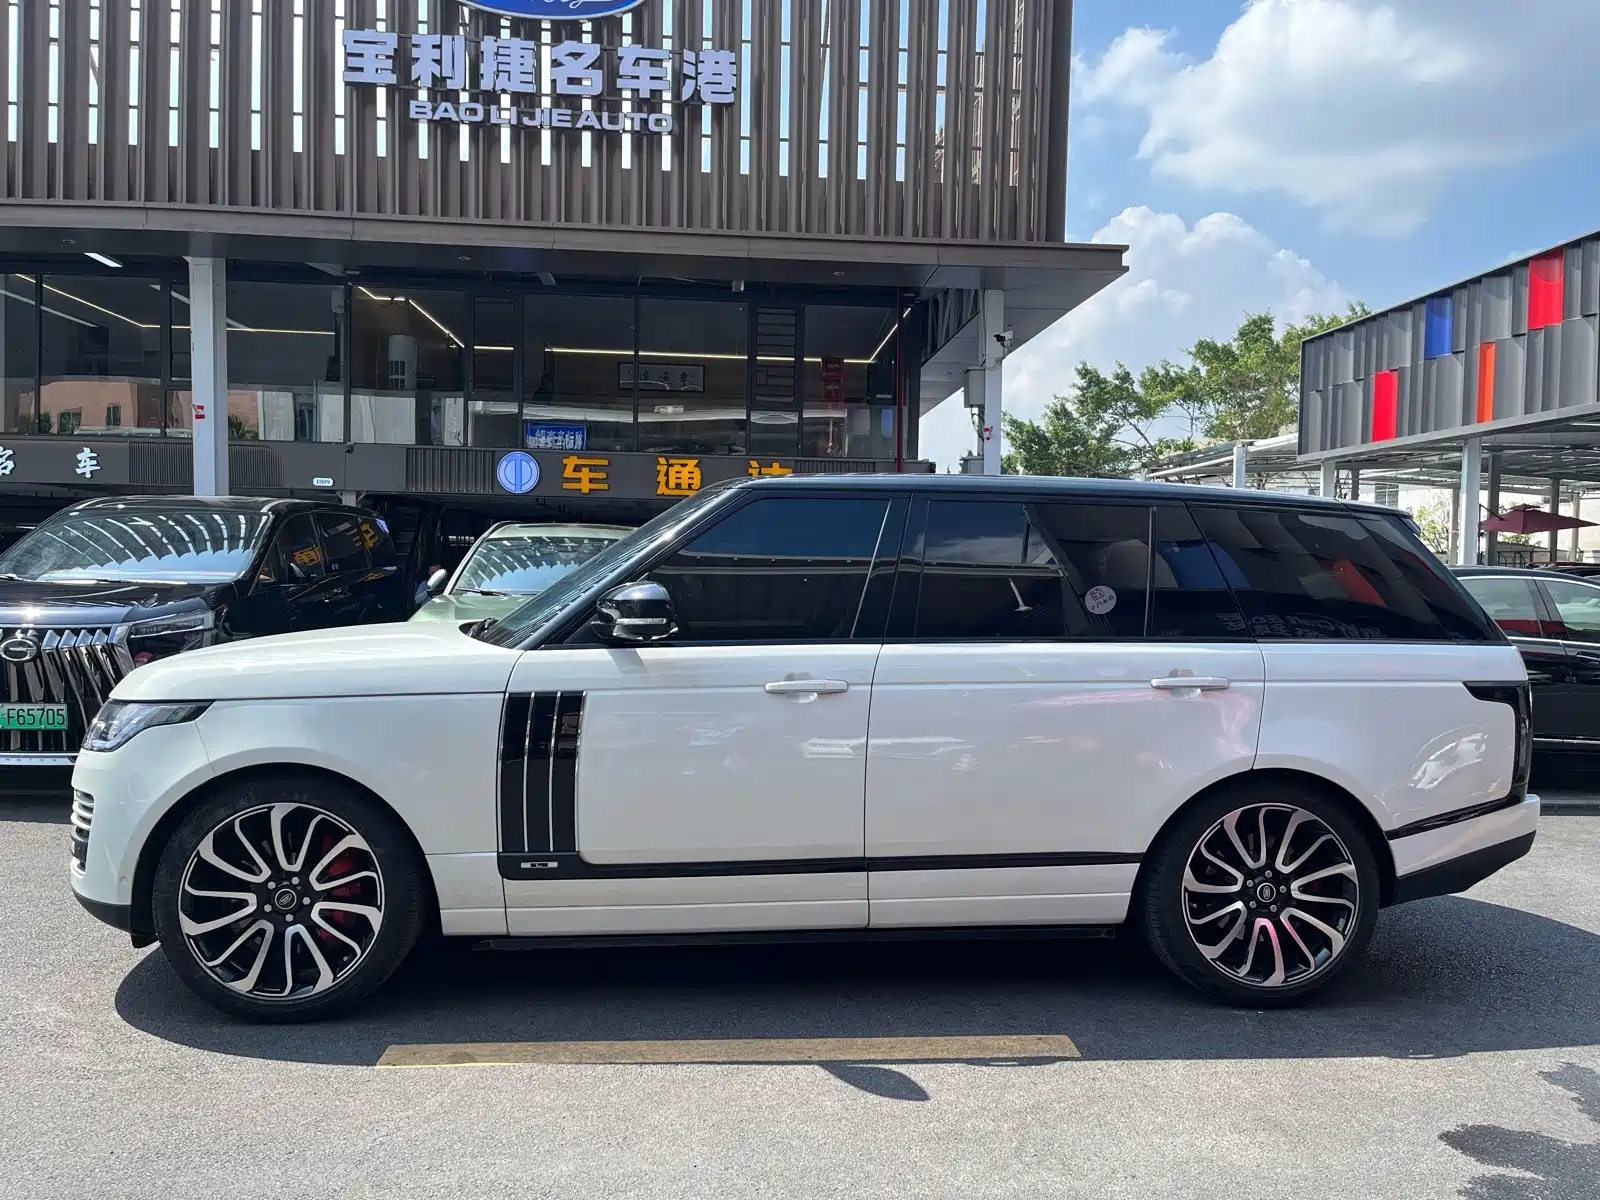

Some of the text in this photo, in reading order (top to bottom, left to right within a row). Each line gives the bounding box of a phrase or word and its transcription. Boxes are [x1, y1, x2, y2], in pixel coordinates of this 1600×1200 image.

[343, 28, 736, 103] 宝利捷名车港
[7, 708, 65, 726] F65705
